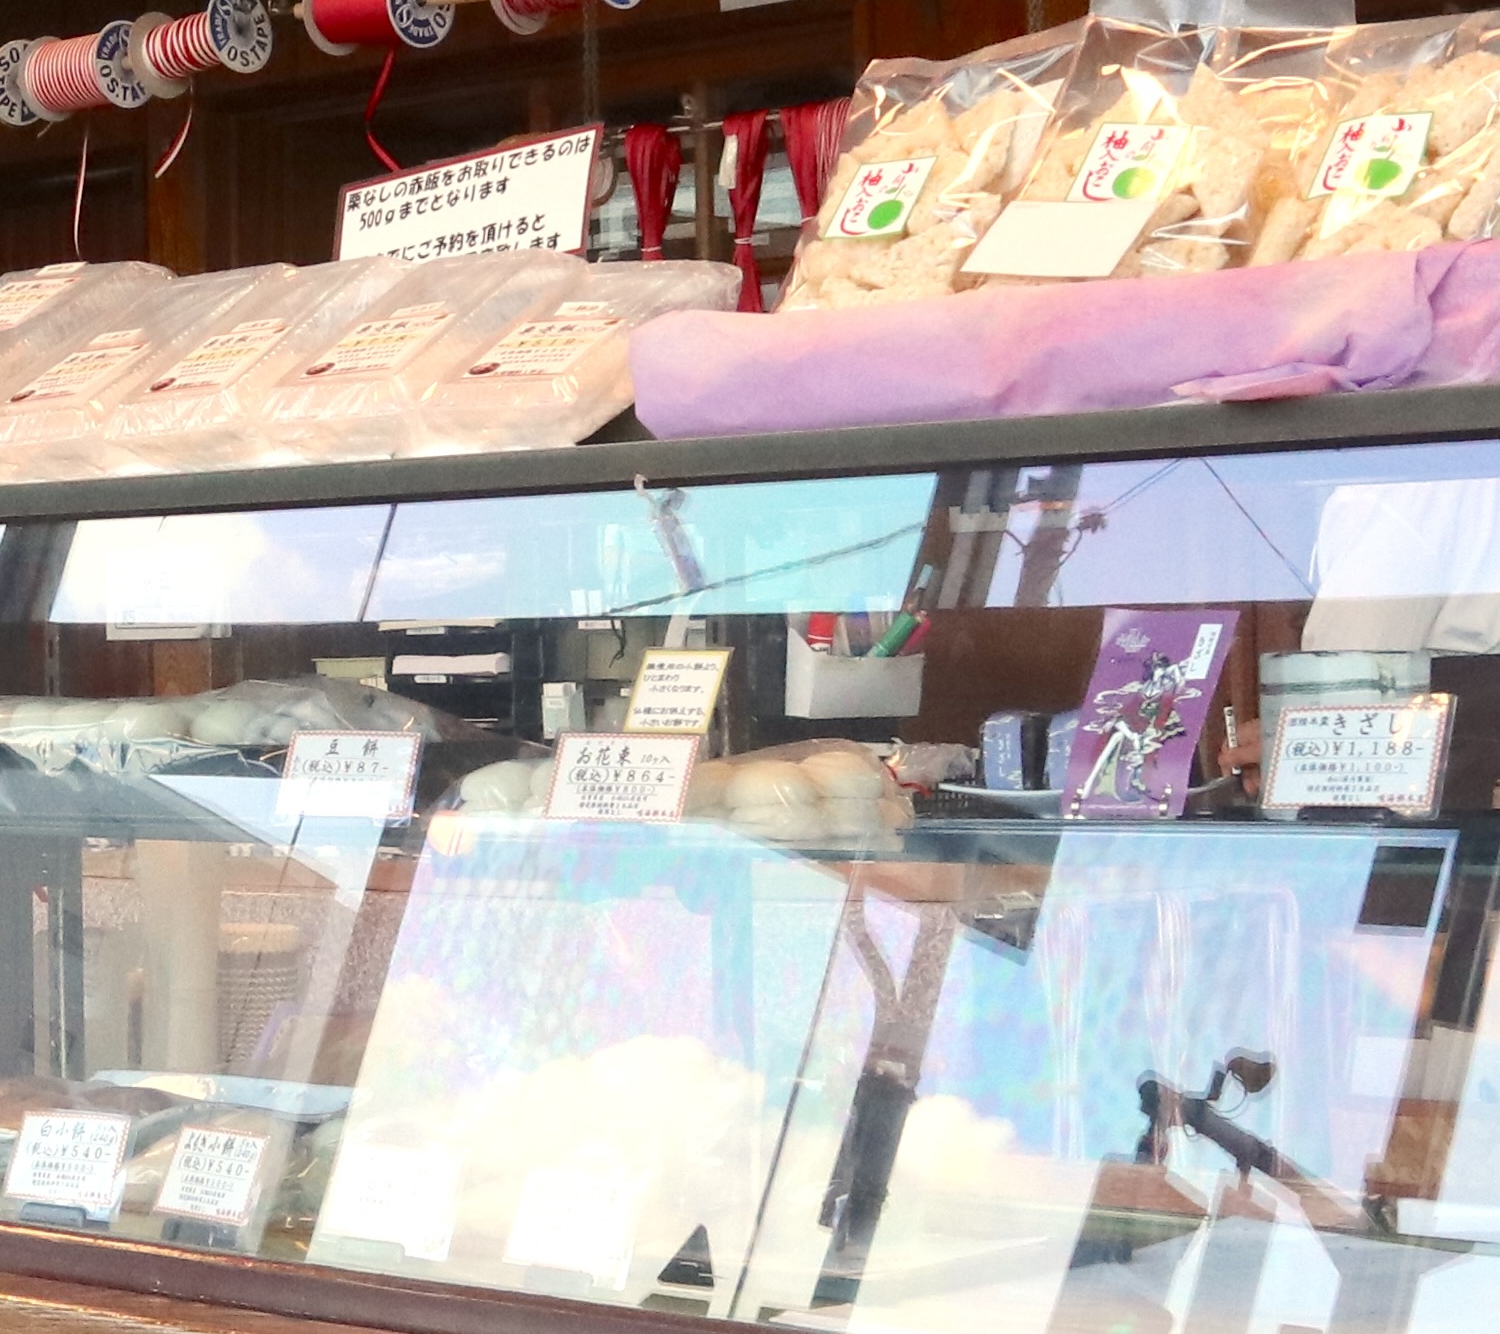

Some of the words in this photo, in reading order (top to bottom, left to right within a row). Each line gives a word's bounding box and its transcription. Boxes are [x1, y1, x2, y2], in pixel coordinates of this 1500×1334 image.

[227, 12, 267, 67] OS.TAPE
[346, 134, 592, 212] 栗なしの赤飯をお取りできるのは
[359, 176, 511, 232] 500gまでとなります
[1332, 712, 1403, 736] きざし
[324, 738, 379, 757] 豆餅
[1285, 740, 1424, 758] (税込)¥1,188-
[568, 768, 676, 784] (税込)¥864-
[39, 1119, 88, 1143] 白小餅
